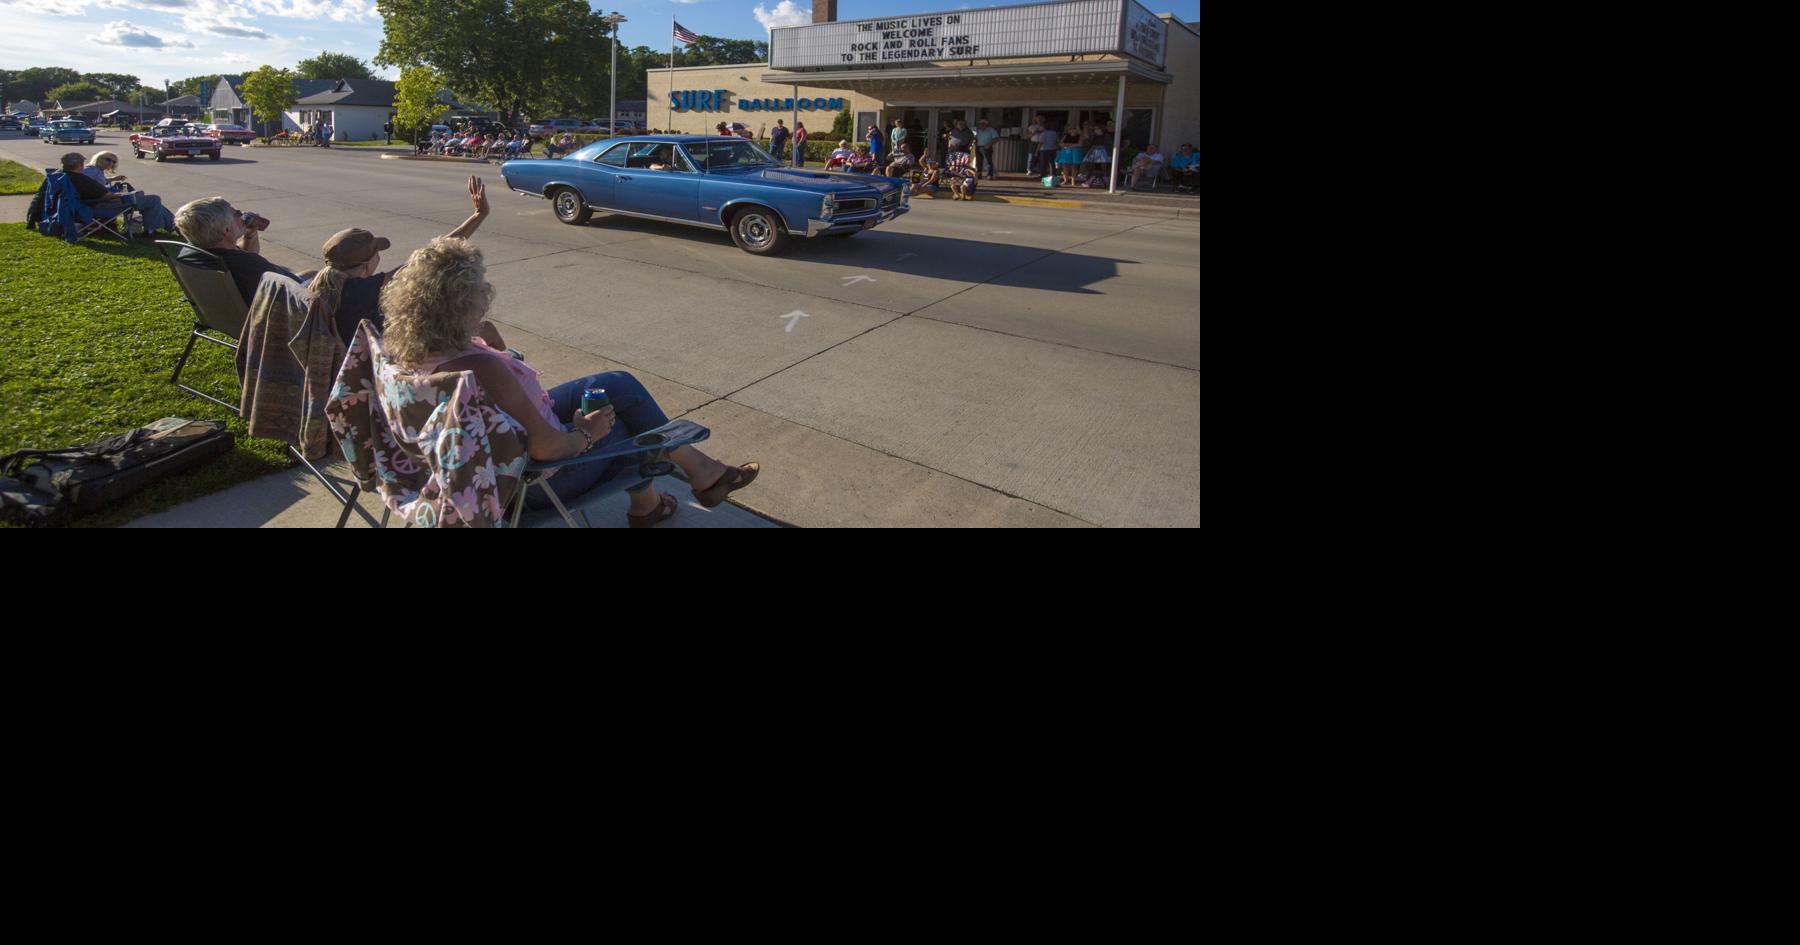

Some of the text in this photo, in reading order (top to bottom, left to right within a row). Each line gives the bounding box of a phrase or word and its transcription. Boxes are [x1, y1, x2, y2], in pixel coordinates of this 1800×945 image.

[857, 15, 960, 32] THE MUSIC LIVES ON
[882, 28, 933, 40] WELCOME
[851, 35, 969, 52] ROCK AND ROLL FANS
[841, 45, 980, 62] TO THE LEGENDARY SURF
[669, 89, 843, 111] SURF BALLROOM
